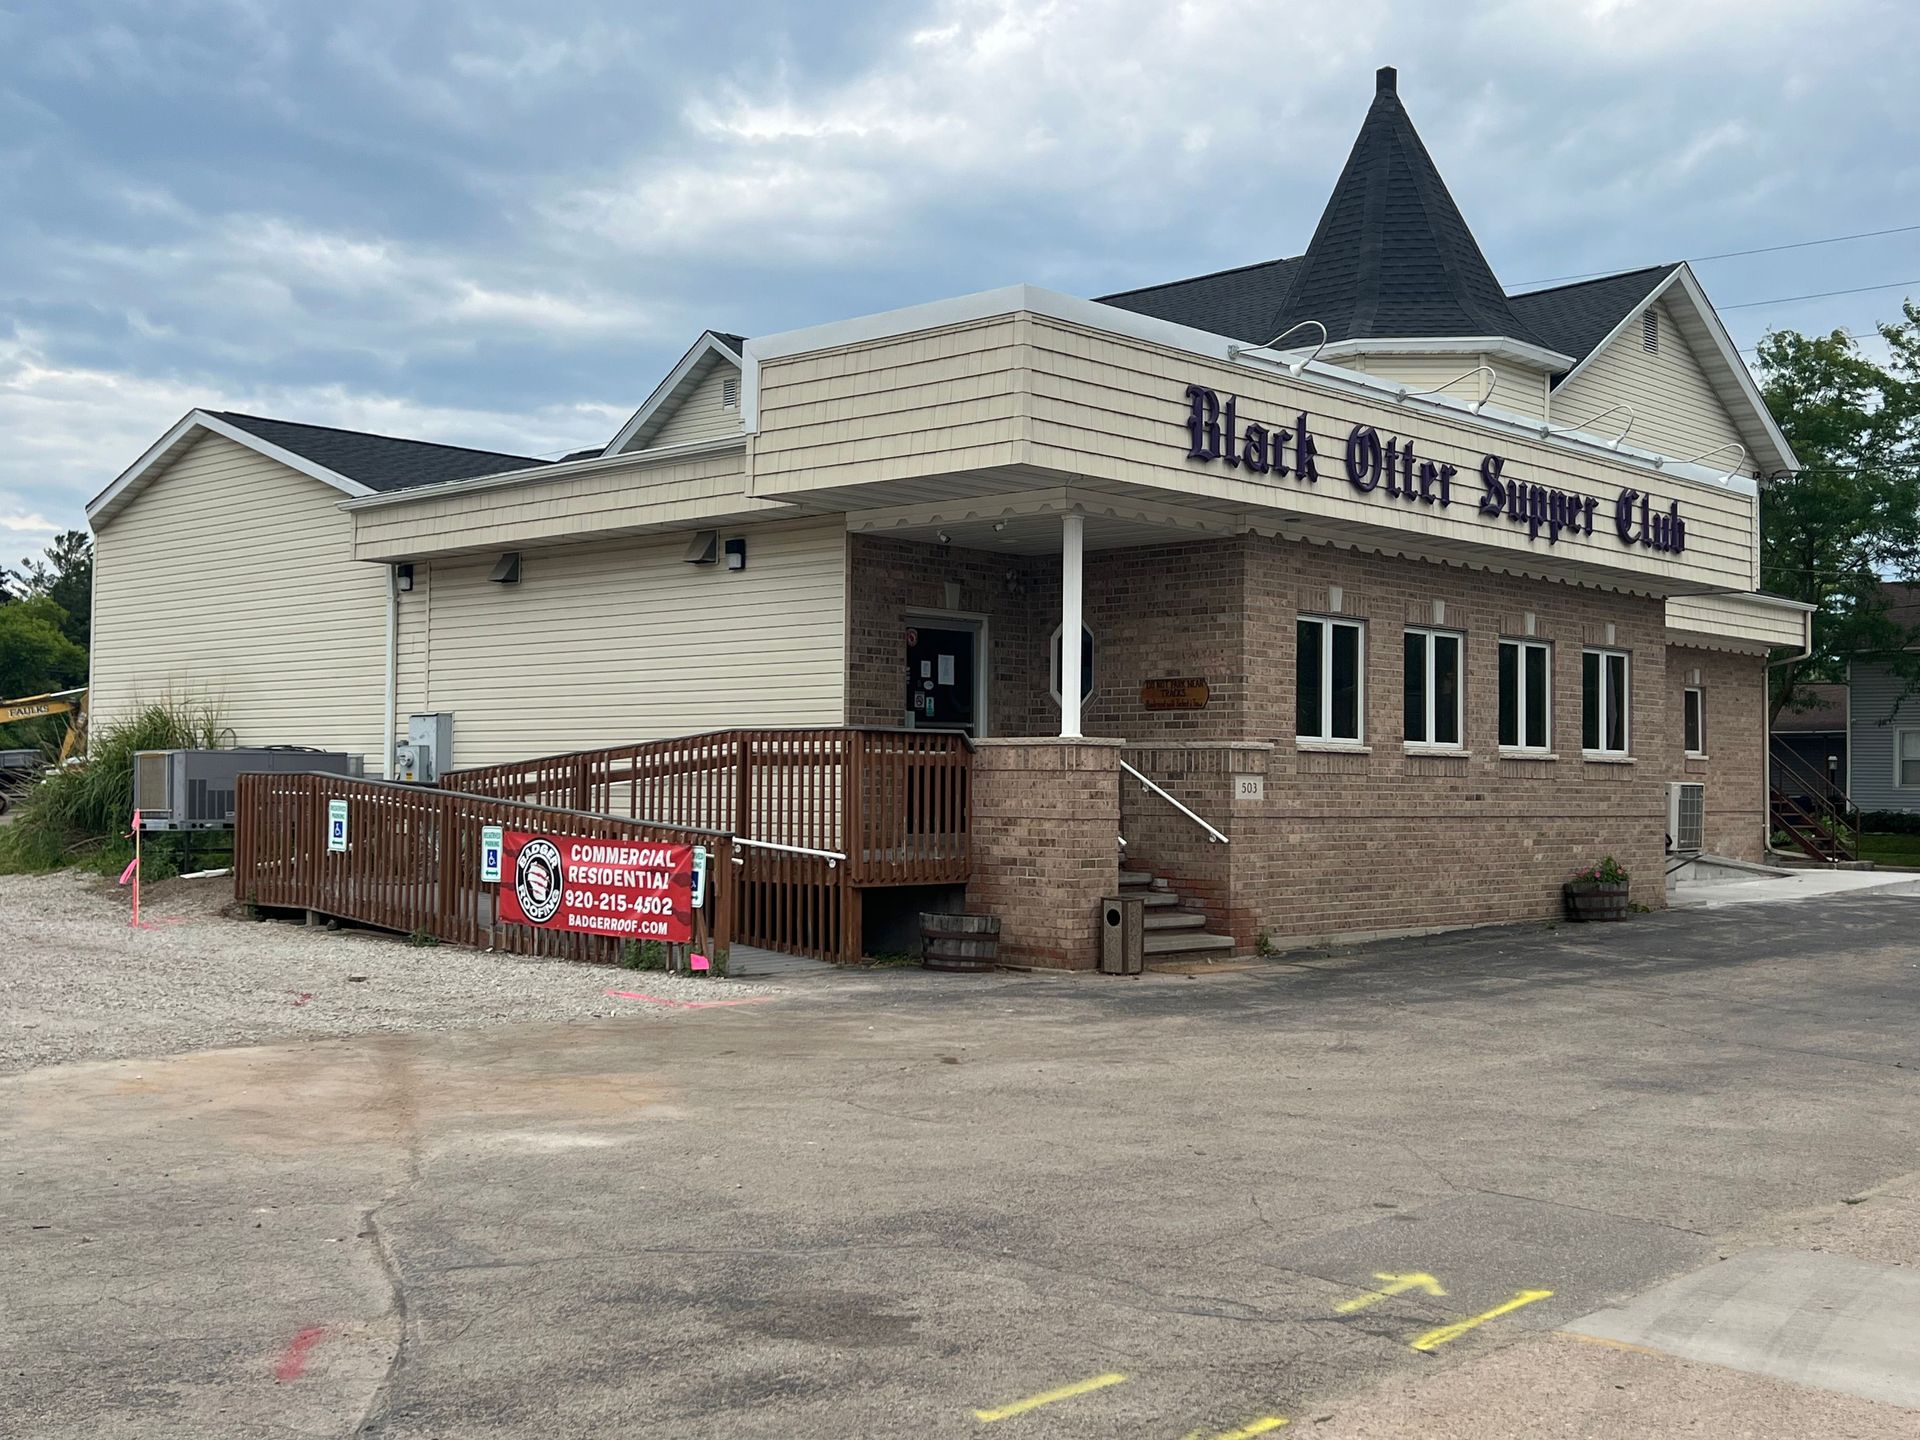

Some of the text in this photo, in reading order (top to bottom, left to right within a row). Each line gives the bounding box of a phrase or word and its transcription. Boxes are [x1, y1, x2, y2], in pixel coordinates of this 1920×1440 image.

[1186, 384, 1685, 554] Black Otter Supper Club
[8, 705, 49, 718] FAULKS
[1241, 783, 1258, 794] 503
[519, 844, 558, 869] BADGER
[571, 844, 676, 868] COMMERCIAL
[568, 865, 669, 890] RESIDENTIAL
[519, 884, 559, 918] ROOFING
[565, 890, 673, 915] 920-215-4502
[568, 914, 668, 935] BADGERROOF.COM
